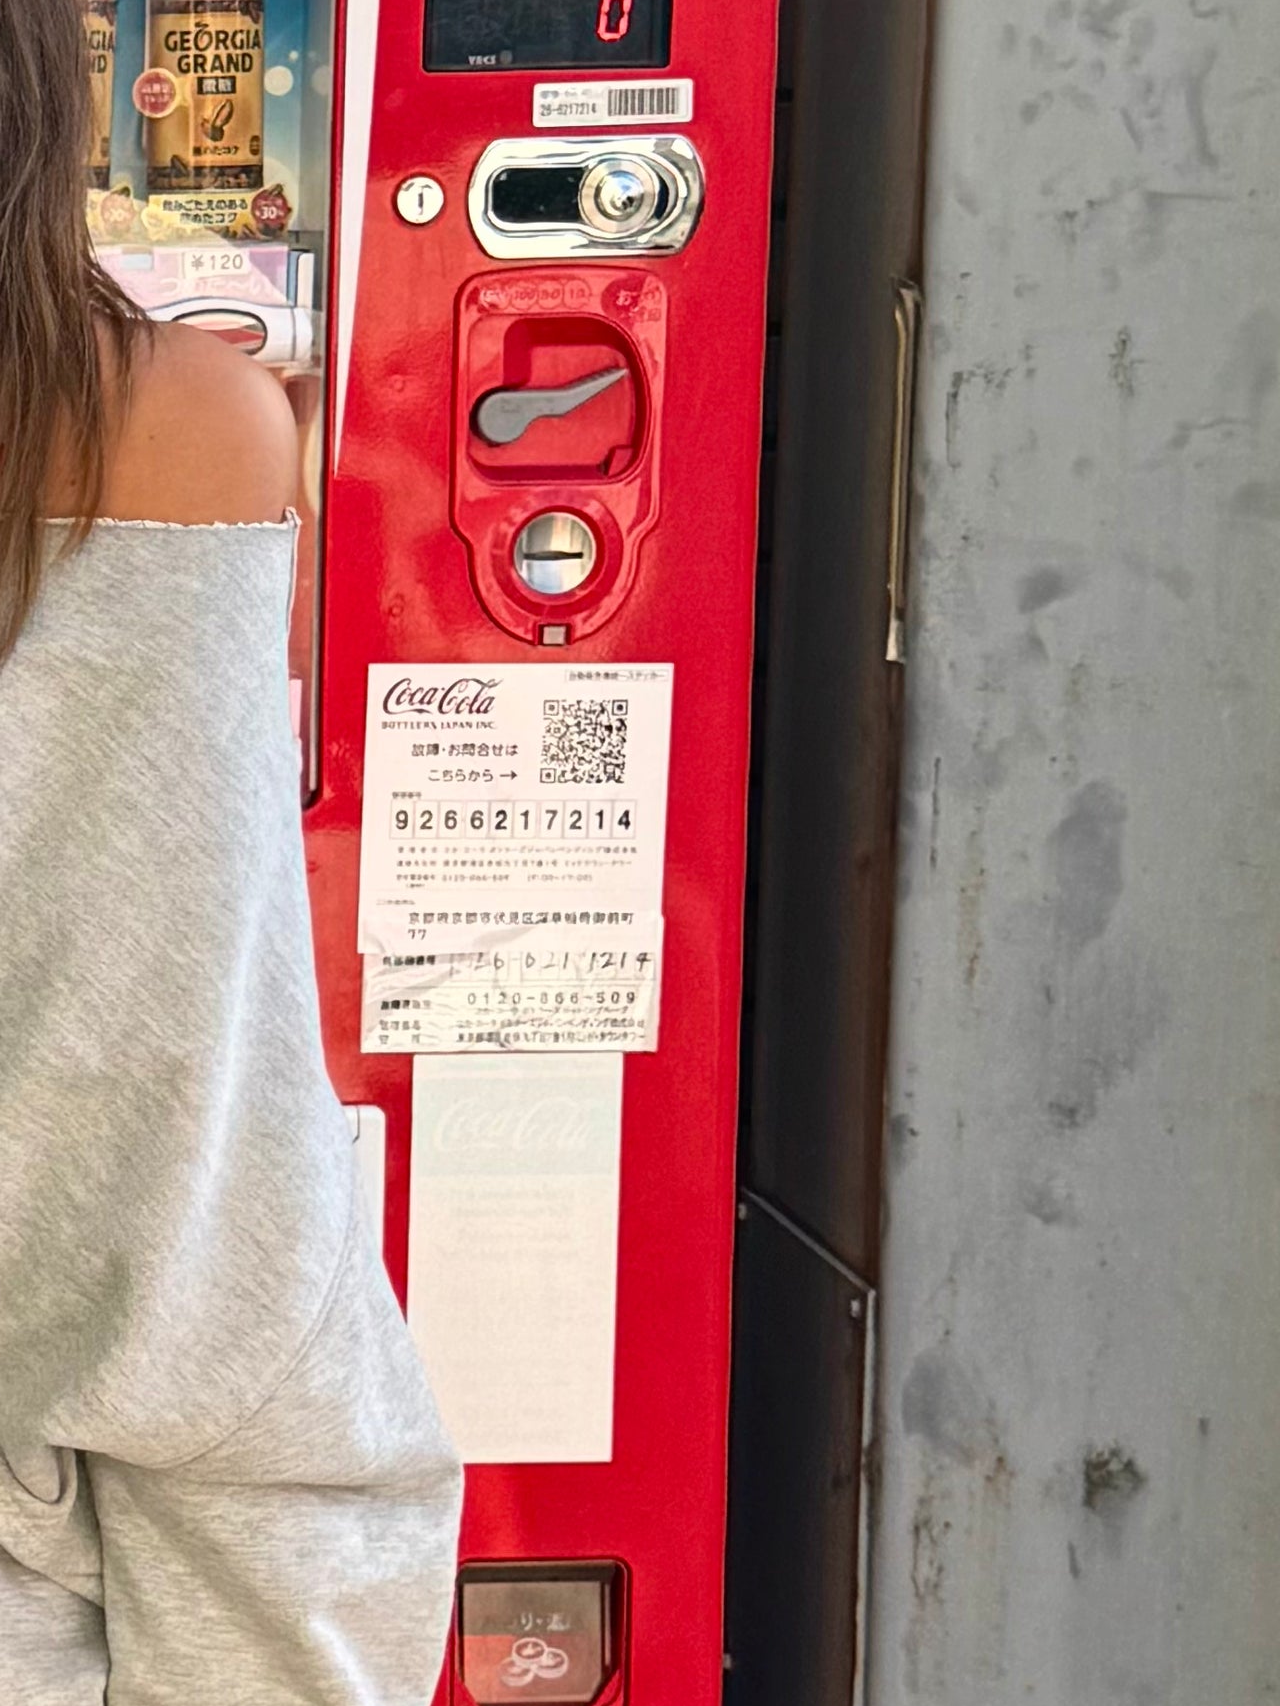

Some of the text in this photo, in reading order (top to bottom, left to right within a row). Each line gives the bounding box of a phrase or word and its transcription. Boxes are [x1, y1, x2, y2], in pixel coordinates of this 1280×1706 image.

[164, 22, 262, 53] GEORGIA
[177, 53, 254, 74] GRAND
[190, 254, 244, 271] ¥120
[382, 677, 503, 715] Coca-Cola
[427, 768, 494, 782] こちらから
[394, 809, 633, 831] 9266217214
[408, 929, 427, 940] 77
